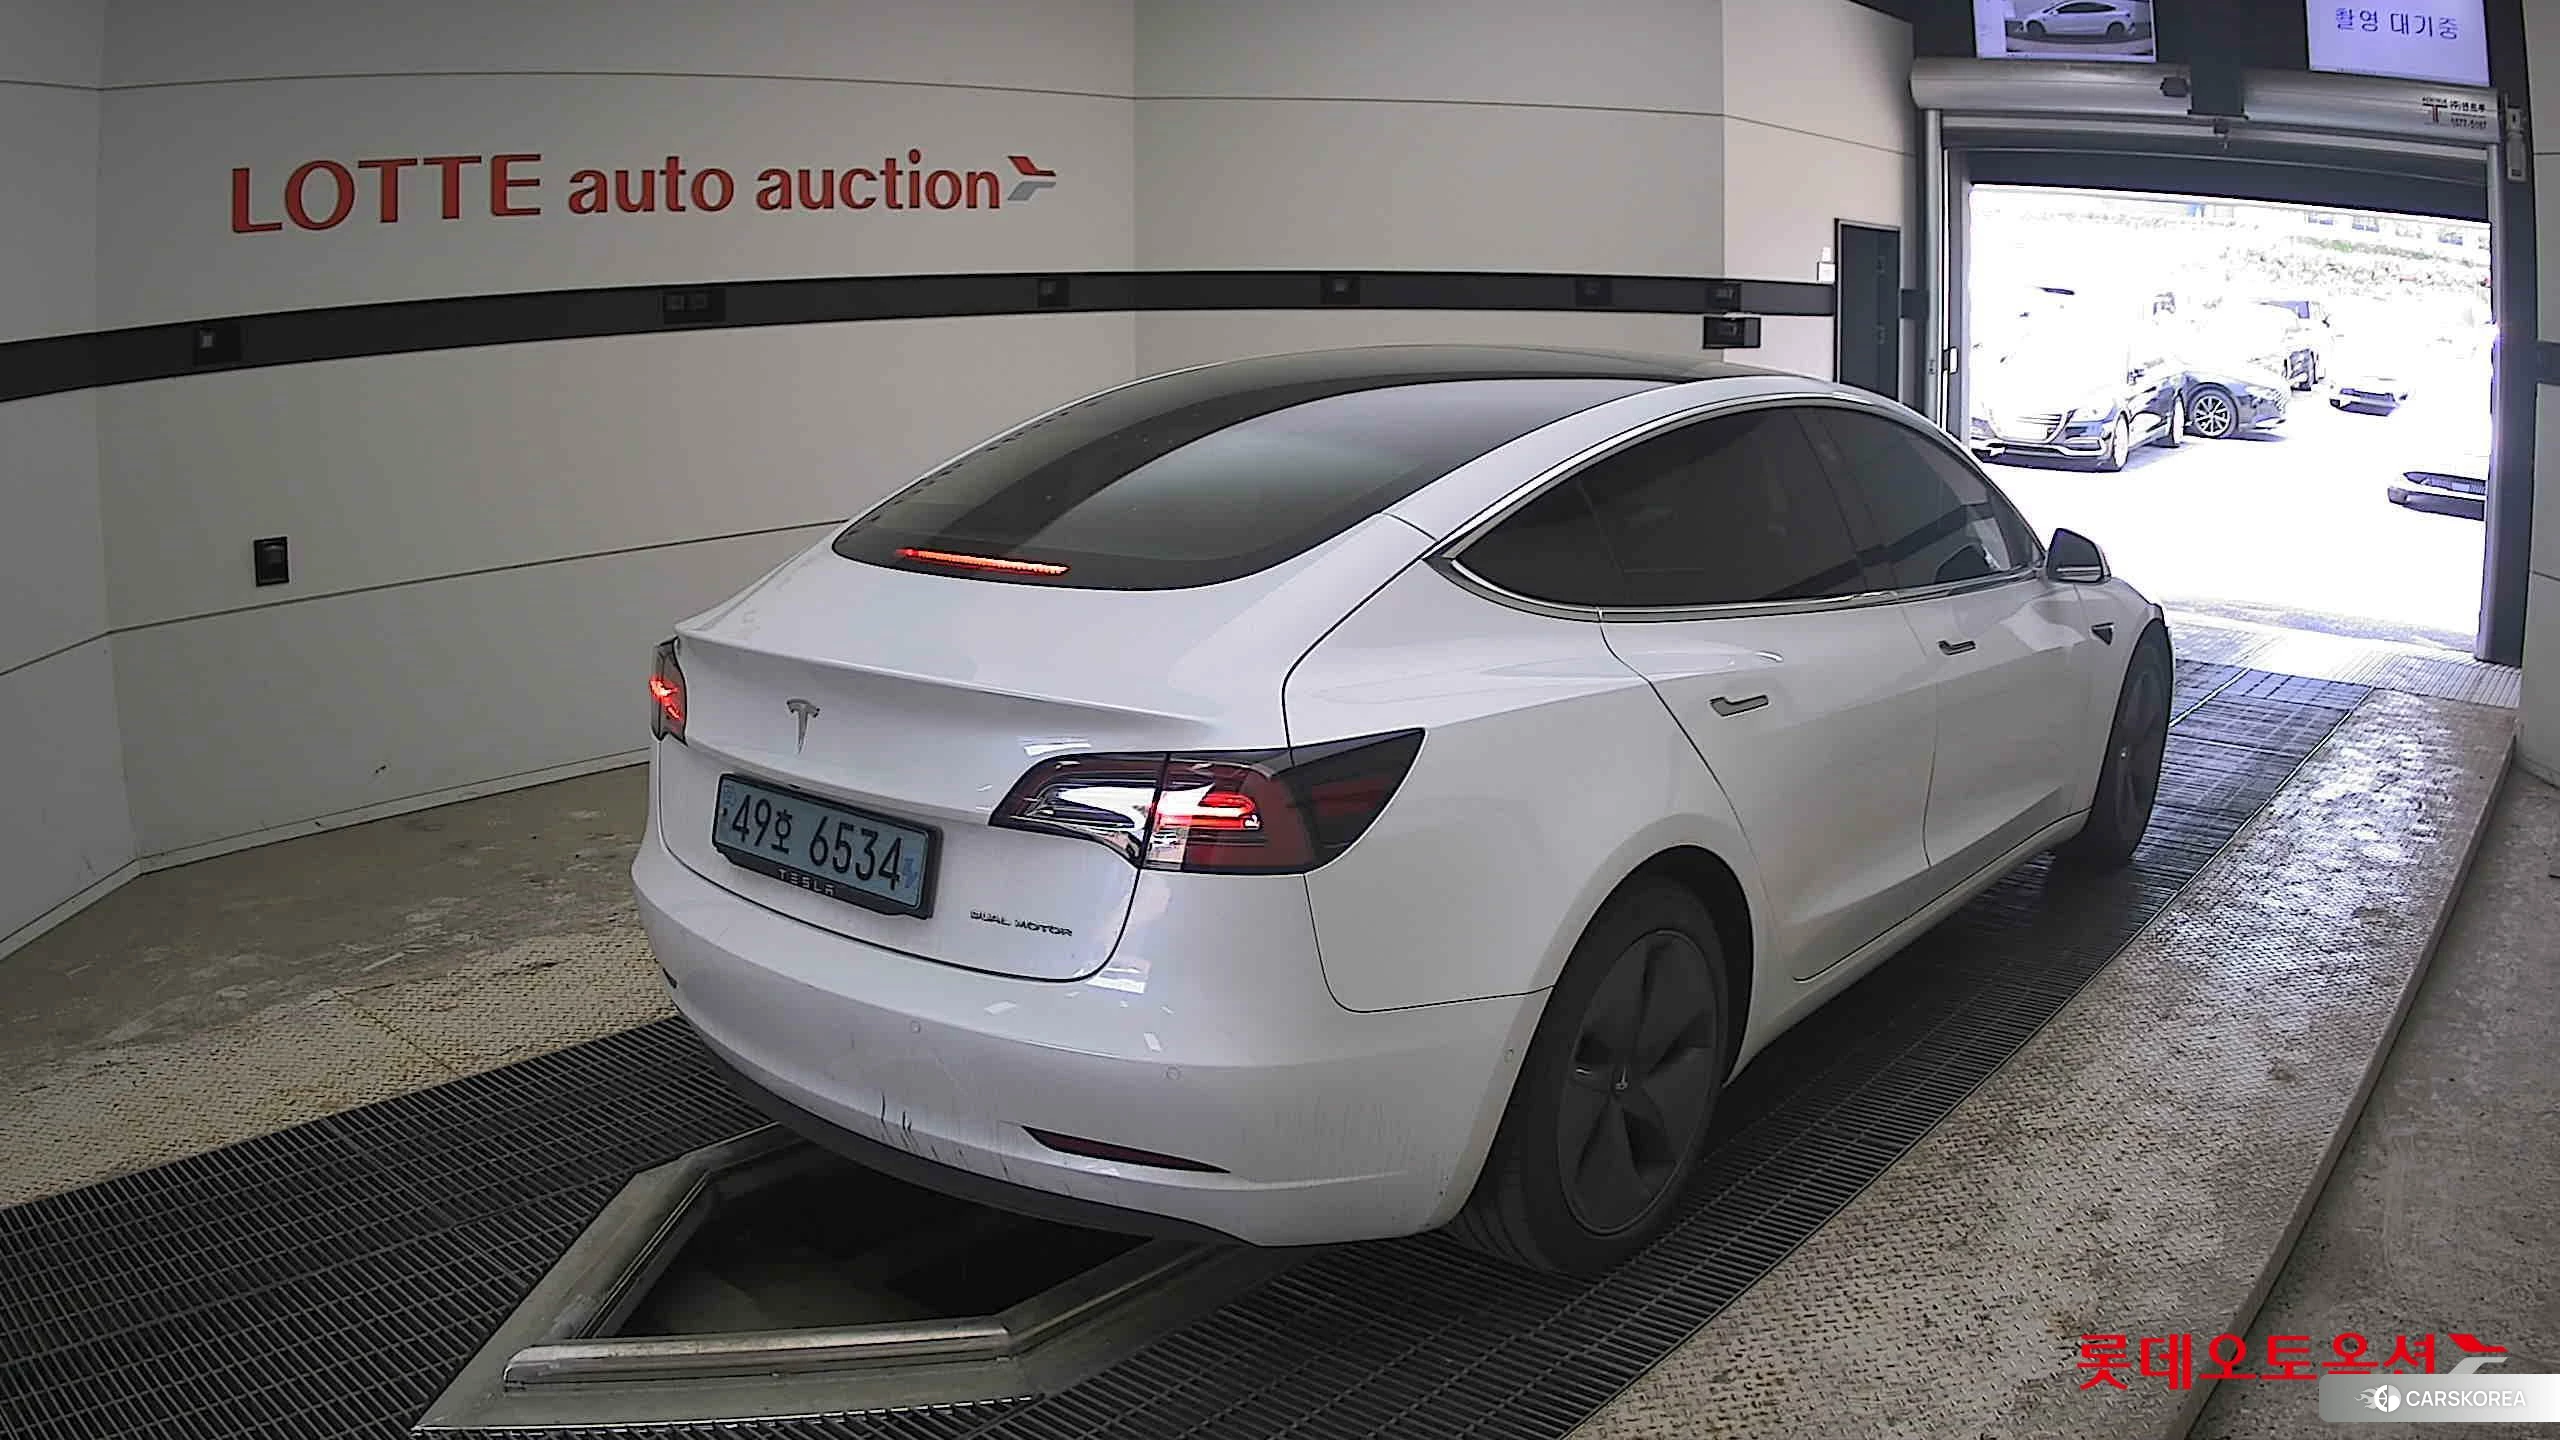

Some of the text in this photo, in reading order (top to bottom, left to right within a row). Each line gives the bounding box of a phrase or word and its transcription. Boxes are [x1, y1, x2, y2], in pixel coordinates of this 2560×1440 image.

[2335, 7, 2458, 40] 촬영 대기중
[232, 148, 1001, 233] LOTTE auto auction
[731, 793, 904, 891] 49호 6534
[776, 868, 836, 897] TESLA
[969, 910, 1073, 937] DUAL MOTOR
